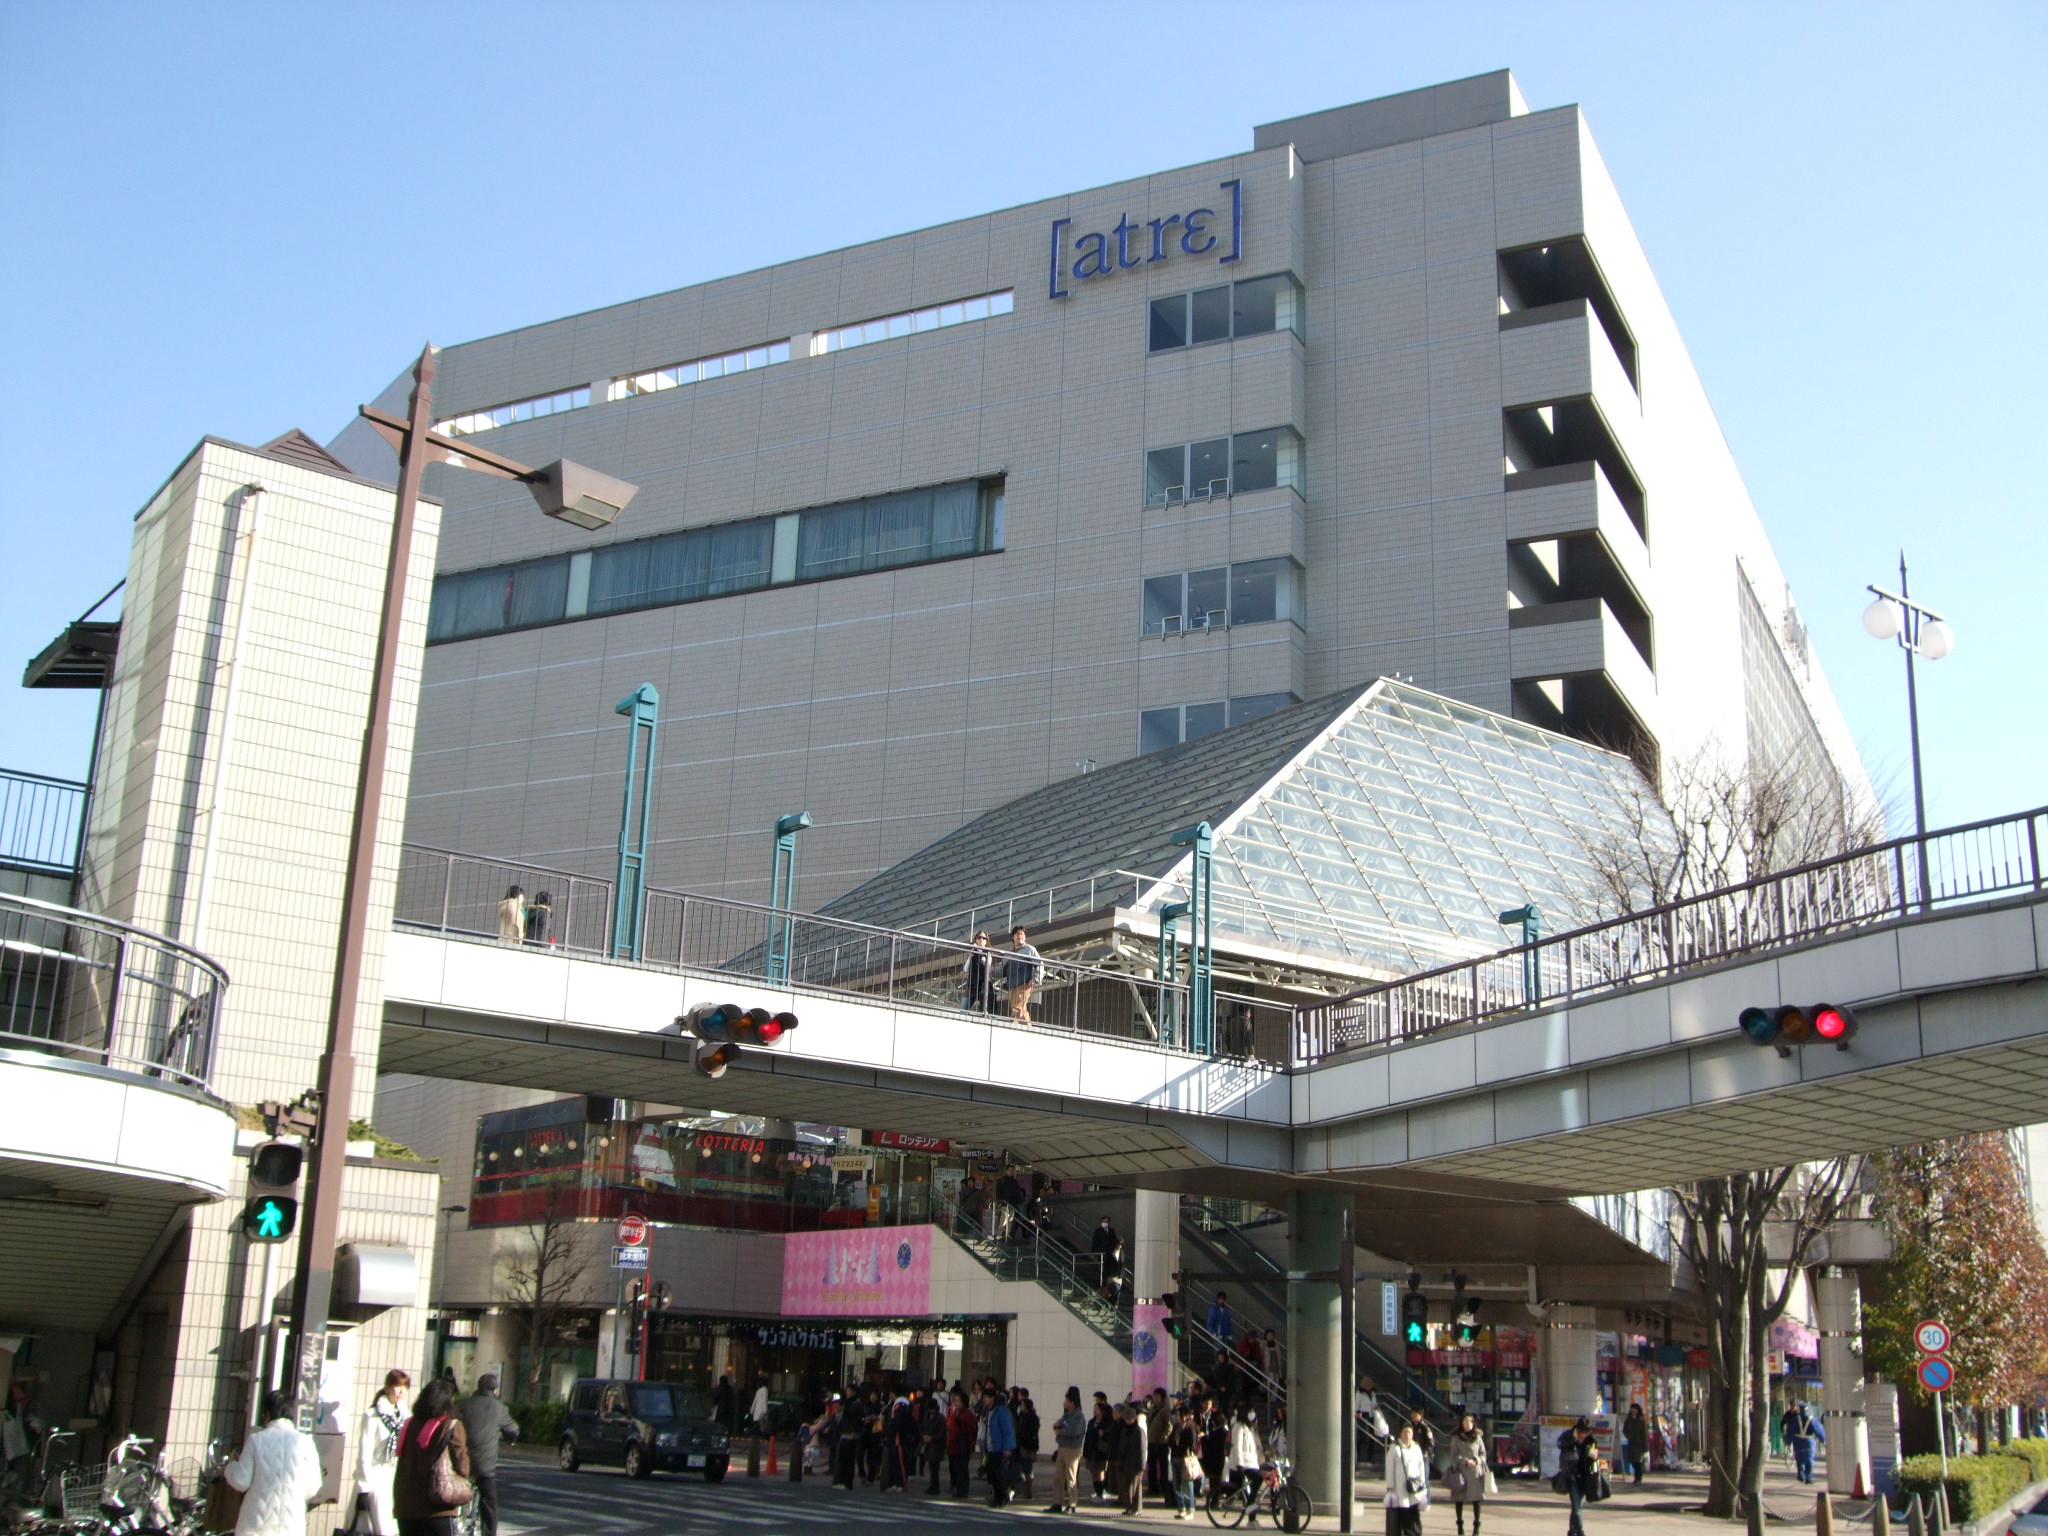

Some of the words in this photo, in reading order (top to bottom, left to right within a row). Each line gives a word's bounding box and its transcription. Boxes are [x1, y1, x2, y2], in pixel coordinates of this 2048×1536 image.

[695, 1134, 766, 1153] LOTTERIA
[899, 1134, 940, 1147] ロッテリア
[832, 1159, 867, 1168] クリスマスチキン
[758, 1329, 835, 1350] サンマルクカフェ
[1922, 1330, 1942, 1346] 30
